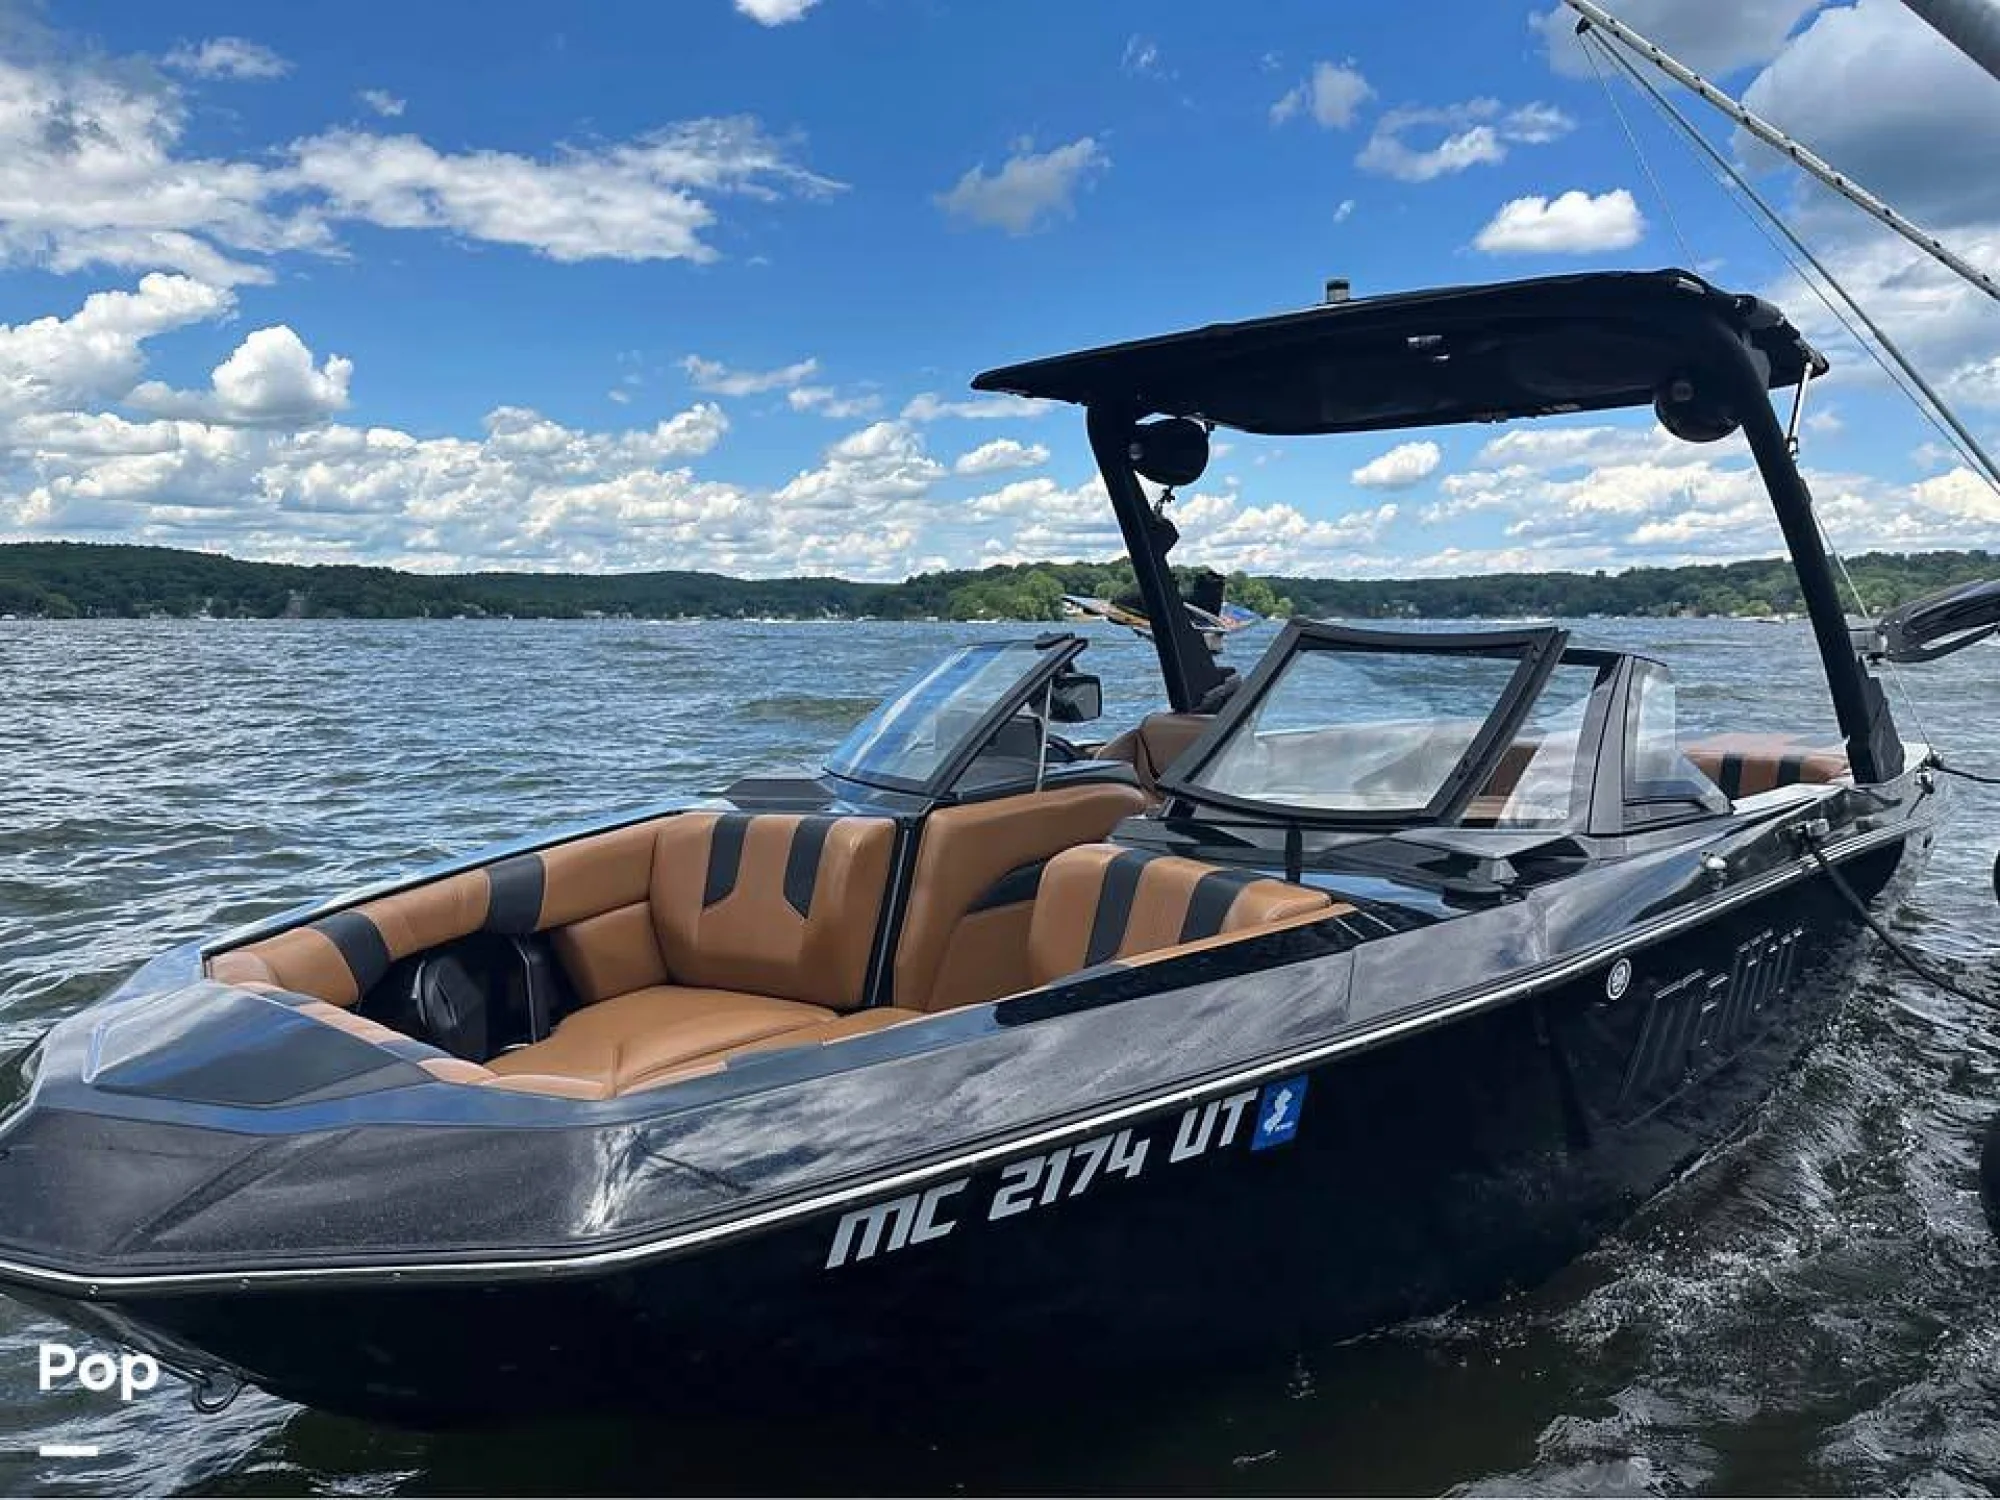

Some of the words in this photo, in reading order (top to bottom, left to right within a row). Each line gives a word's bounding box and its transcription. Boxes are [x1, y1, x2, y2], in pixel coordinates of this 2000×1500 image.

[824, 1177, 971, 1270] MC
[987, 1128, 1151, 1221] 2174
[1169, 1088, 1259, 1164] UT
